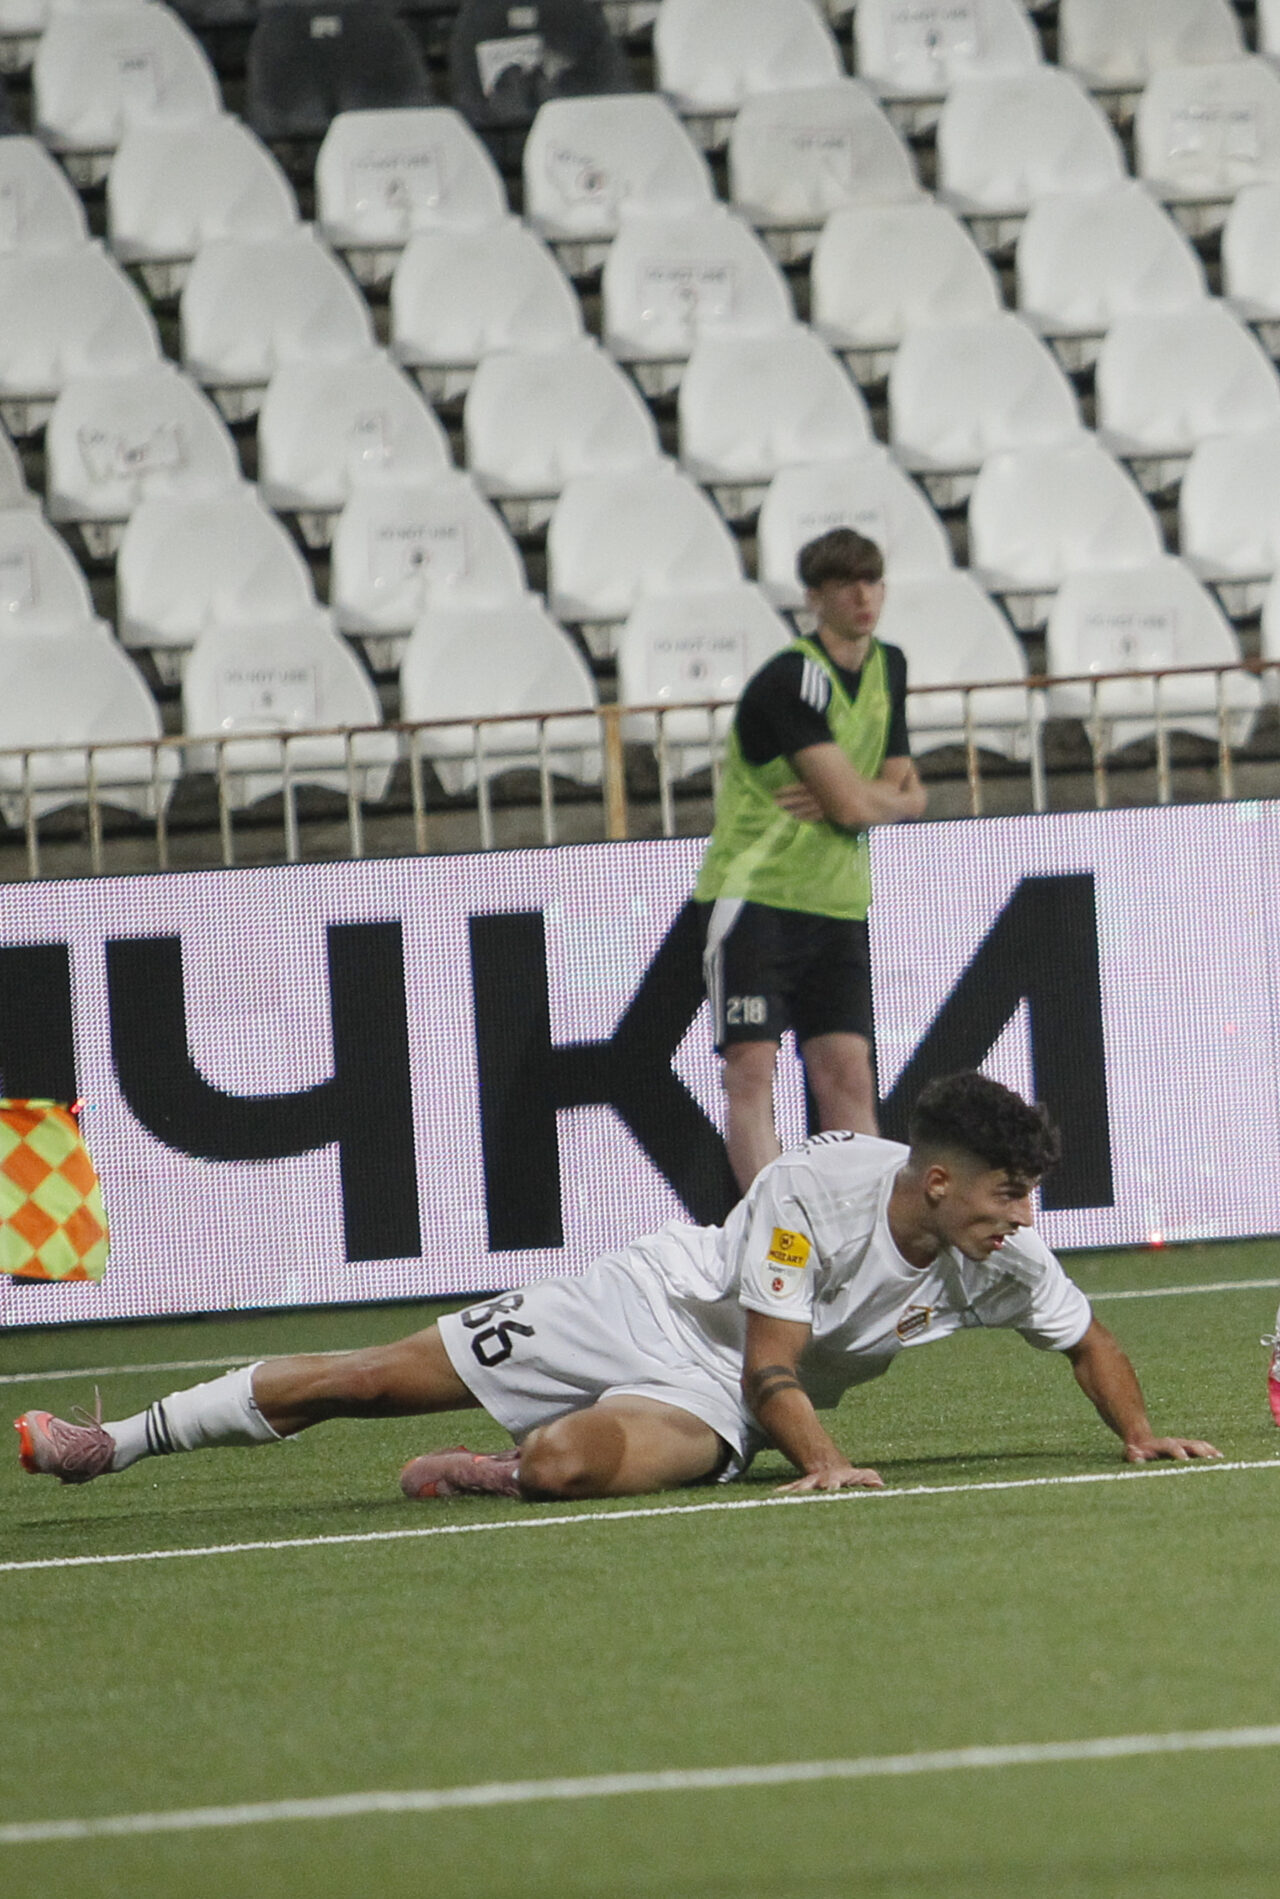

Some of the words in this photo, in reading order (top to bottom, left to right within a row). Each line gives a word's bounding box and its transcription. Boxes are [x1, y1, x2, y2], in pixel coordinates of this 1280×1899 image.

[727, 995, 767, 1024] 218
[0, 872, 1113, 1284] ЧКИ
[460, 1293, 536, 1368] 86
